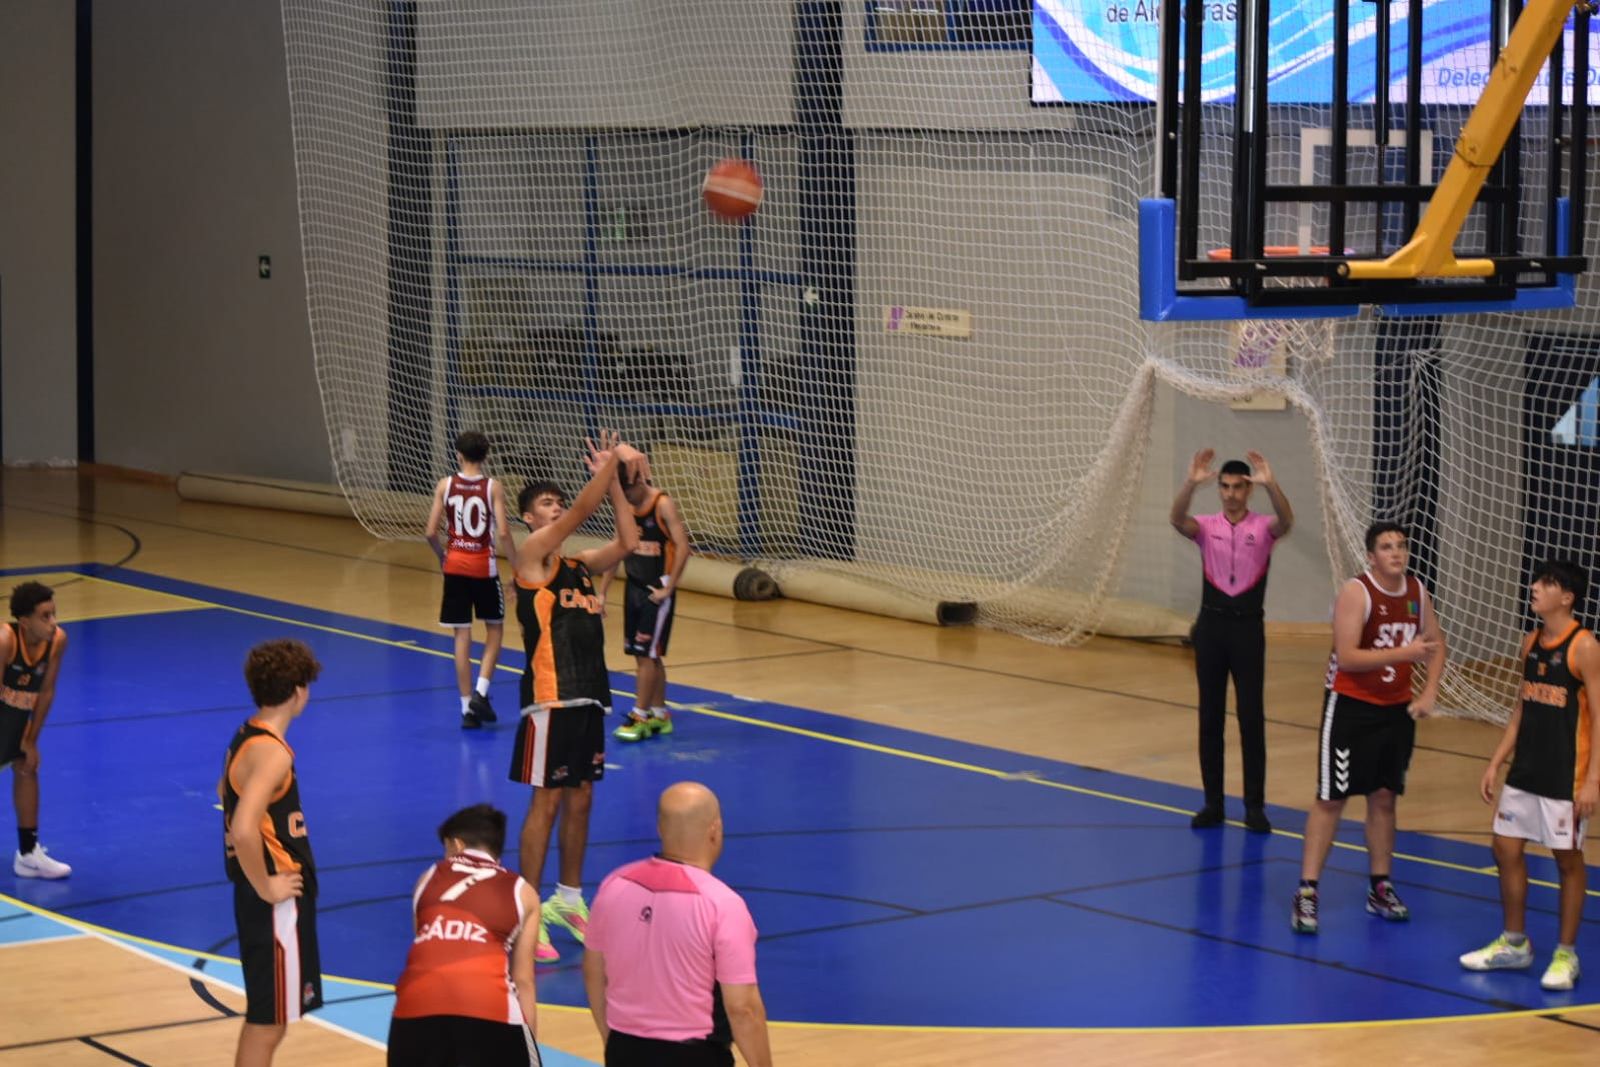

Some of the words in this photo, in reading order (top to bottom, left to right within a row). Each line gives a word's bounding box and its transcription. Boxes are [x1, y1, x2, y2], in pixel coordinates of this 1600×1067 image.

[1106, 3, 1129, 22] de
[447, 494, 487, 538] 10
[440, 862, 498, 902] 7
[414, 914, 489, 944] CÁDIZ
